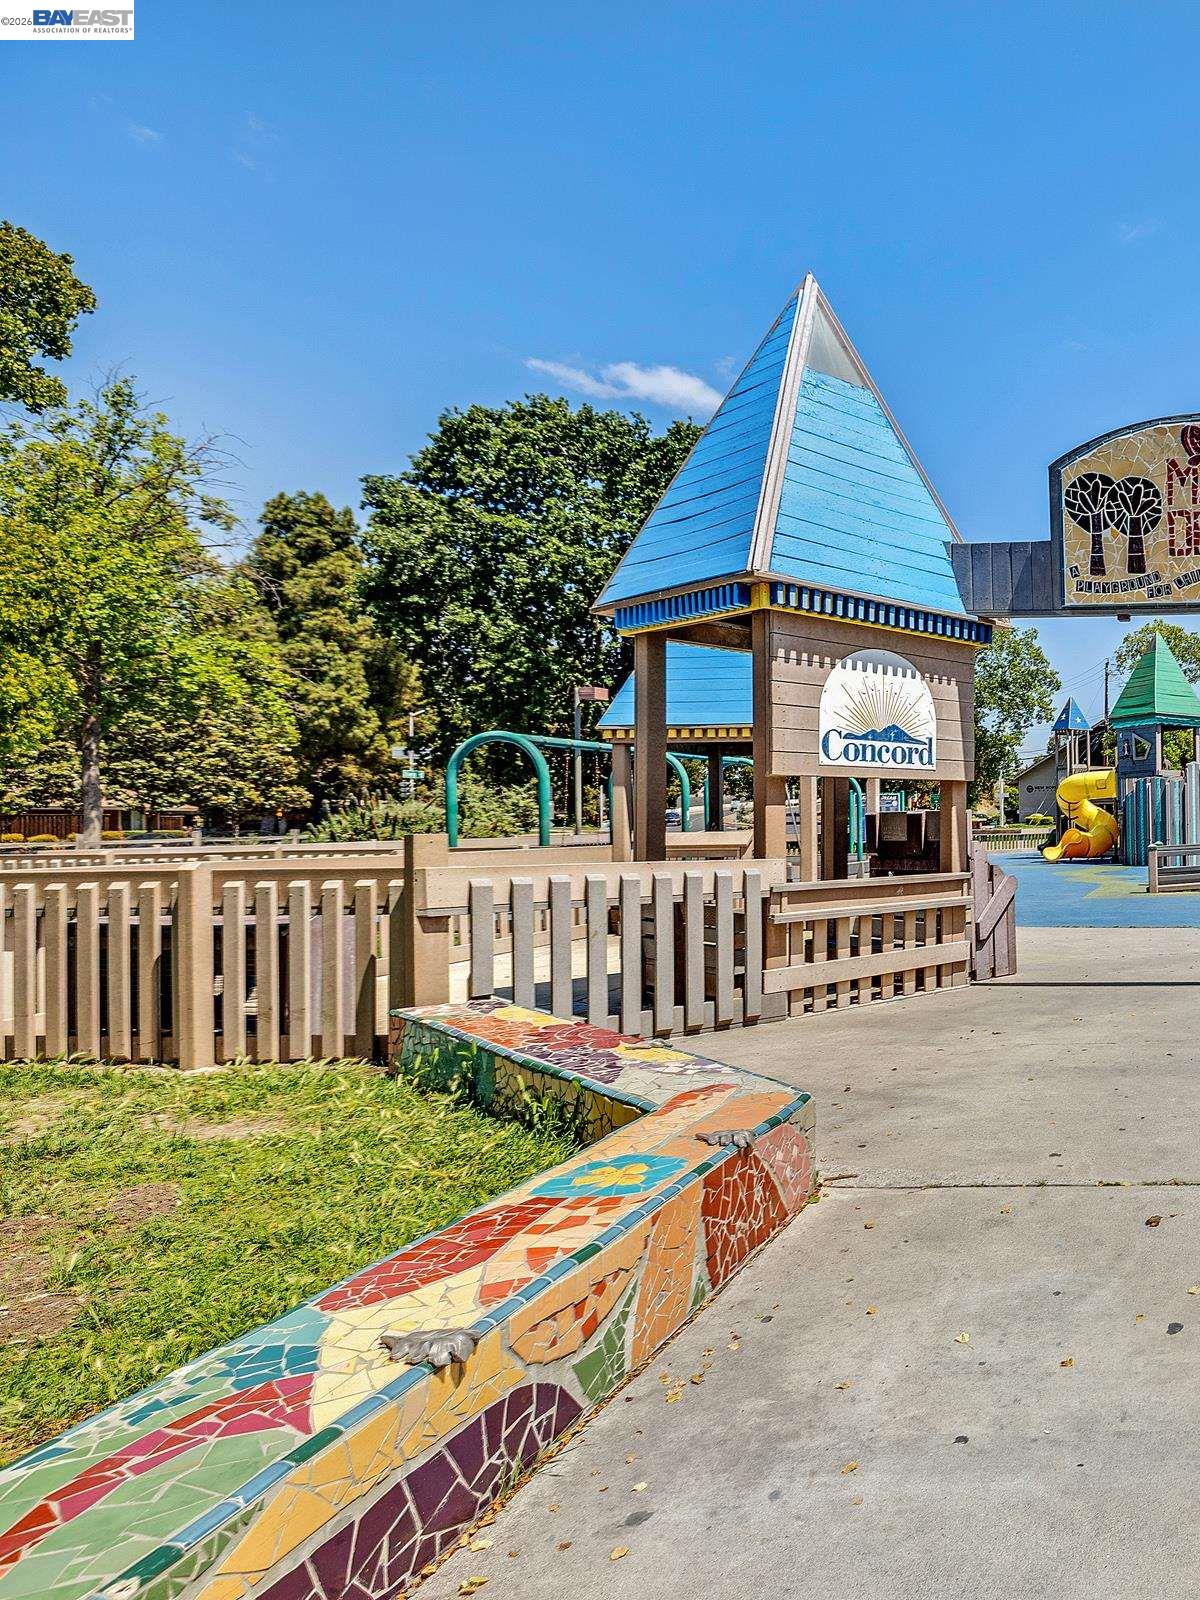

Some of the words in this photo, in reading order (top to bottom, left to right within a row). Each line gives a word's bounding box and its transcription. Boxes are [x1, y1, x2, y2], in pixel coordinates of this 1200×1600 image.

[1069, 565, 1080, 578] A
[1076, 571, 1161, 593] PLAYGROUND
[1147, 584, 1172, 598] FOR
[821, 728, 933, 766] Concord
